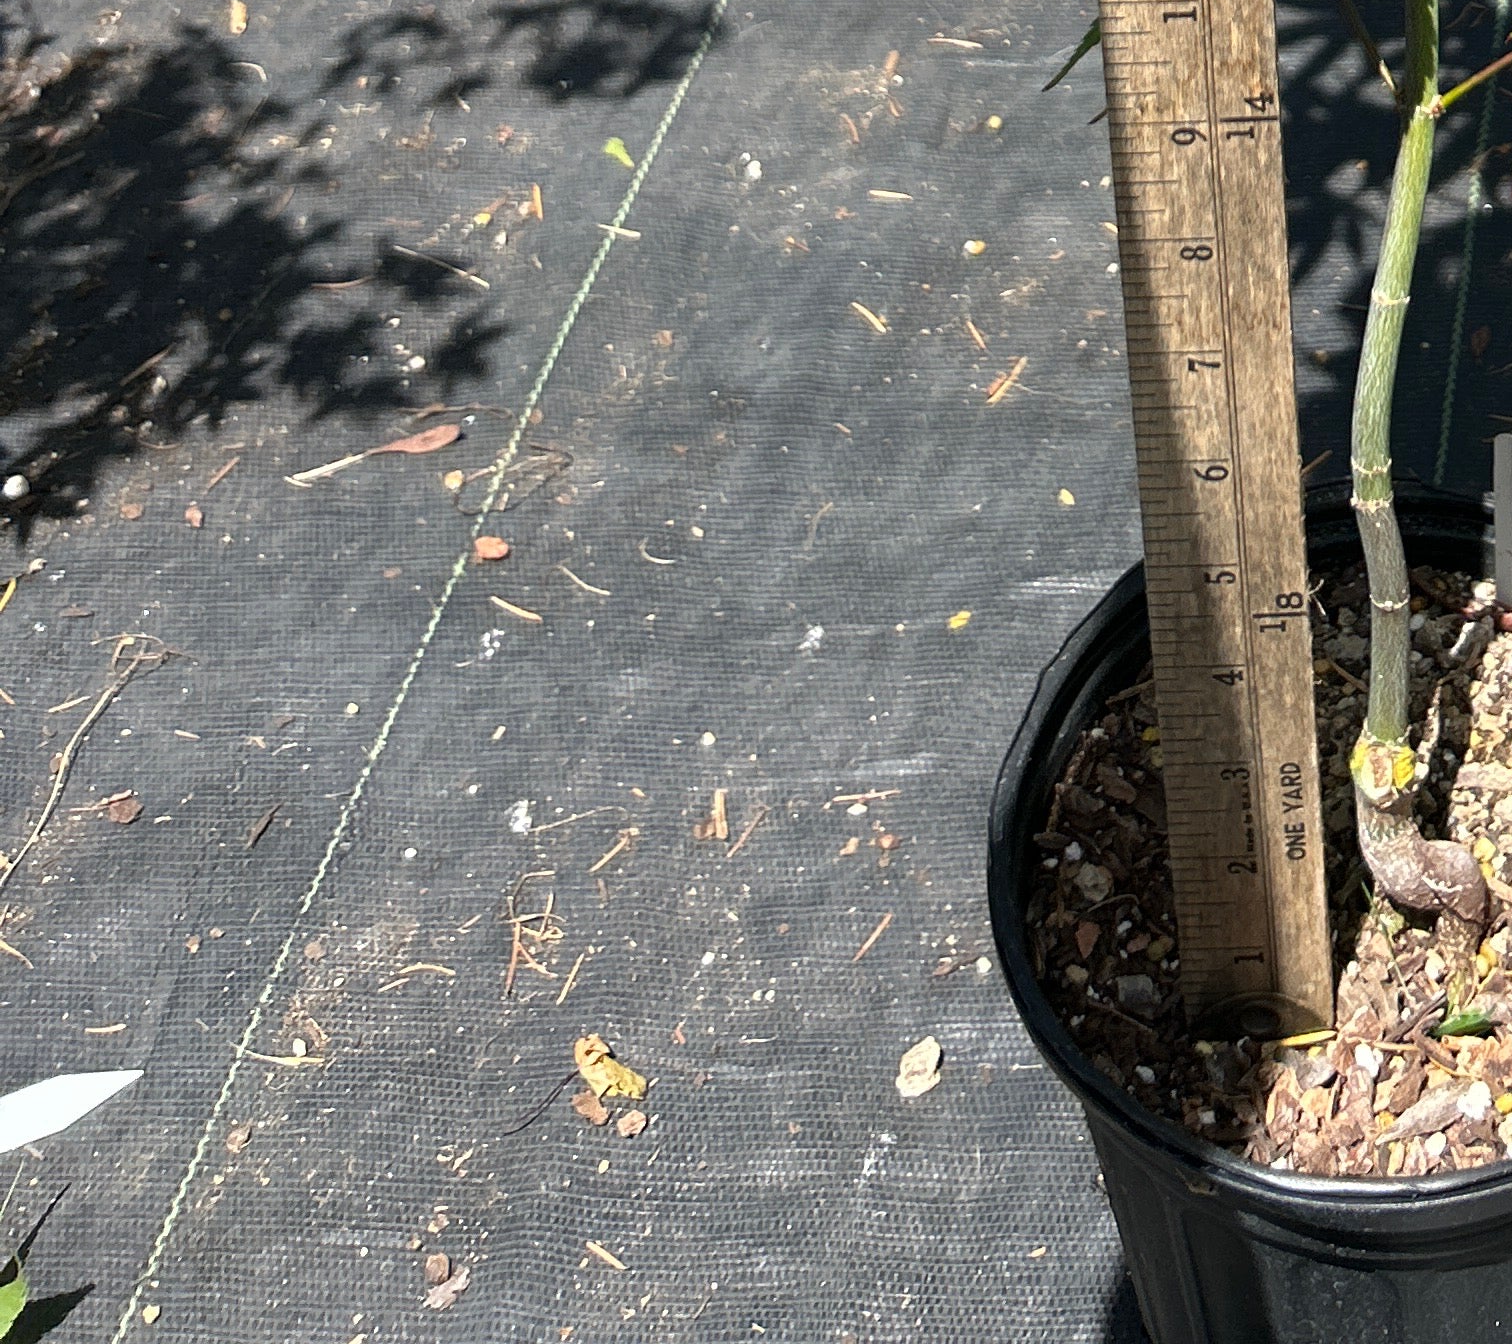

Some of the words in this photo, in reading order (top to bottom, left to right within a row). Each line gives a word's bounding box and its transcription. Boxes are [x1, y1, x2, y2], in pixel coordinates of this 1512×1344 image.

[1171, 126, 1208, 147] 9
[1180, 244, 1214, 261] 8
[1188, 358, 1222, 373] 7
[1194, 464, 1230, 482] 6
[1204, 570, 1237, 585] 5
[1212, 668, 1245, 687] 4
[1220, 766, 1251, 782] 3
[1279, 761, 1302, 814] YARD
[1284, 822, 1307, 861] ONE
[1227, 861, 1258, 875] 2
[1234, 951, 1265, 965] 1
